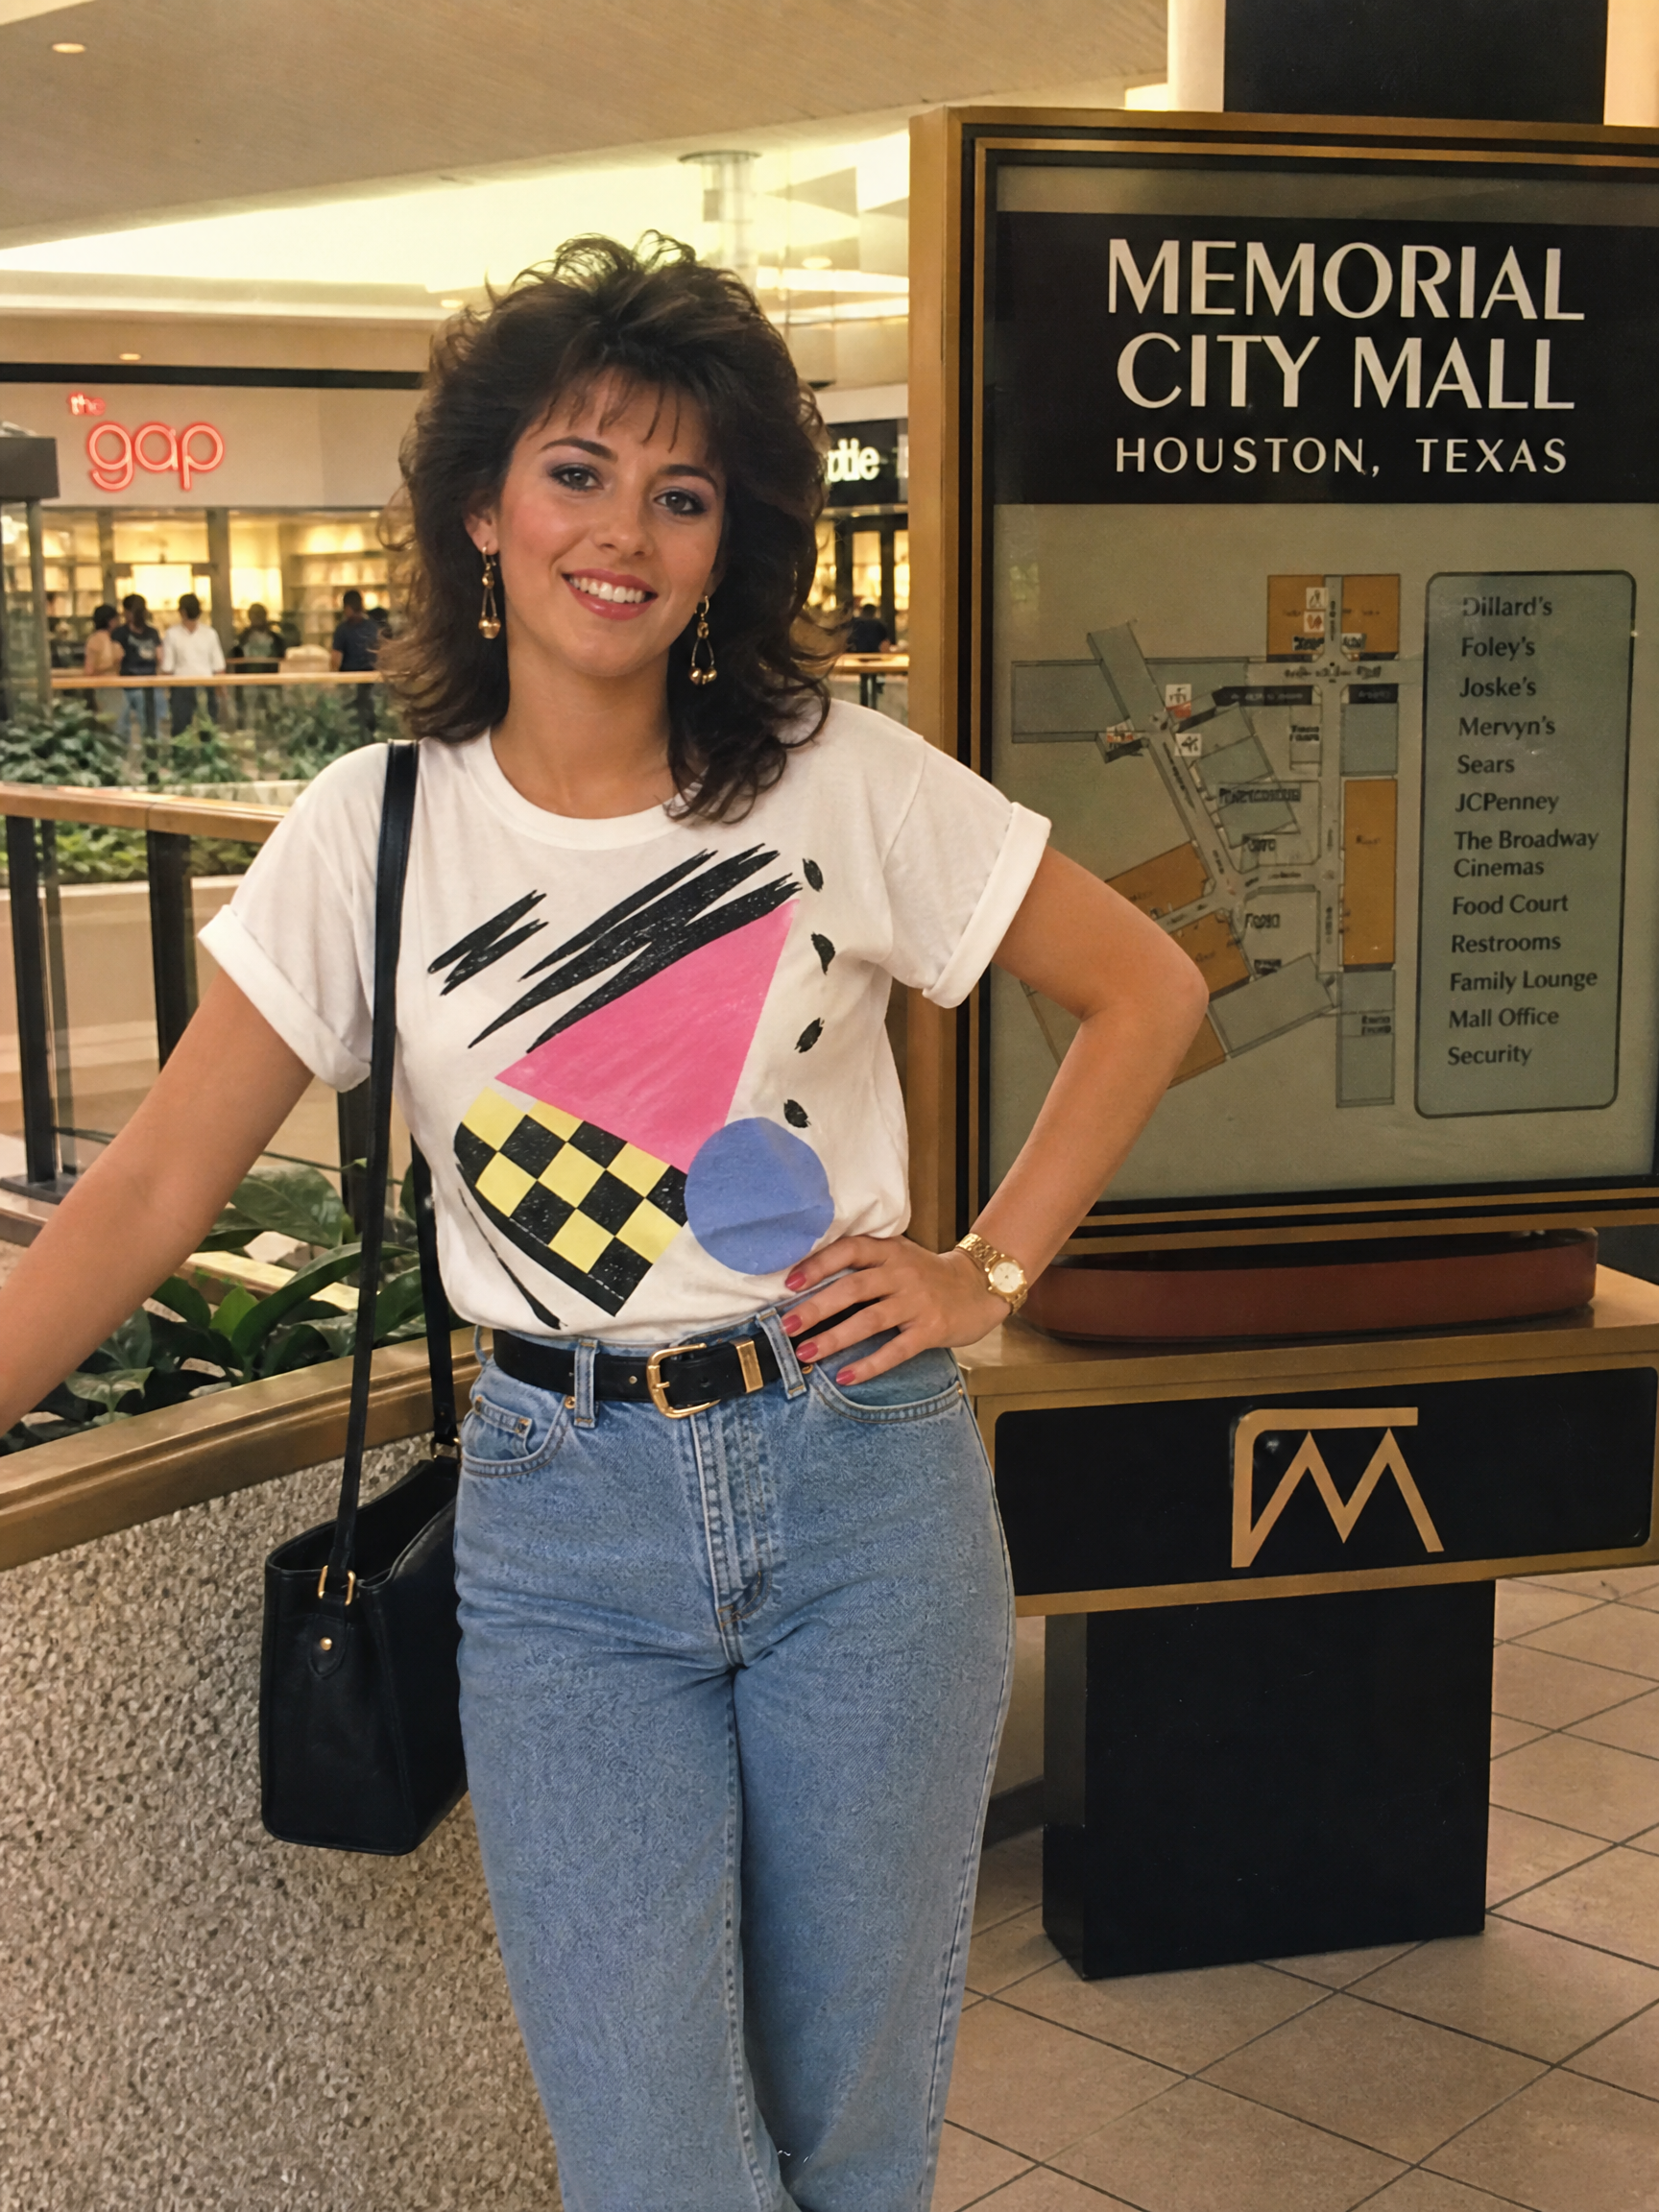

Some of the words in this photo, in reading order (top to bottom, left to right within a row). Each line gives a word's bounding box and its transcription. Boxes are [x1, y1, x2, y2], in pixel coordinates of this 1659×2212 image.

[1108, 238, 1585, 321] MEMORIAL
[1117, 331, 1321, 410] CITY
[1354, 337, 1575, 410] MALL
[87, 421, 225, 492] gap
[1117, 437, 1381, 477] HOUSTON,
[1415, 438, 1567, 474] TEXAS
[1462, 595, 1553, 617] Dillard's
[1461, 636, 1536, 661] Foley's
[1459, 676, 1537, 698] Joske's
[1458, 714, 1556, 740] Mervyn's
[1456, 754, 1516, 775] Sears
[1455, 791, 1559, 815] JCPenney
[1454, 830, 1493, 851] The
[1499, 829, 1599, 850] Broadway
[1453, 857, 1545, 878] Cinemas
[1452, 895, 1504, 916] Food
[1508, 894, 1569, 914] Court
[1451, 934, 1562, 954] Restrooms
[1450, 971, 1517, 995] Family
[1522, 970, 1599, 992] Lounge
[1449, 1009, 1493, 1029] Mall
[1498, 1006, 1560, 1027] Office
[1447, 1044, 1532, 1067] Security
